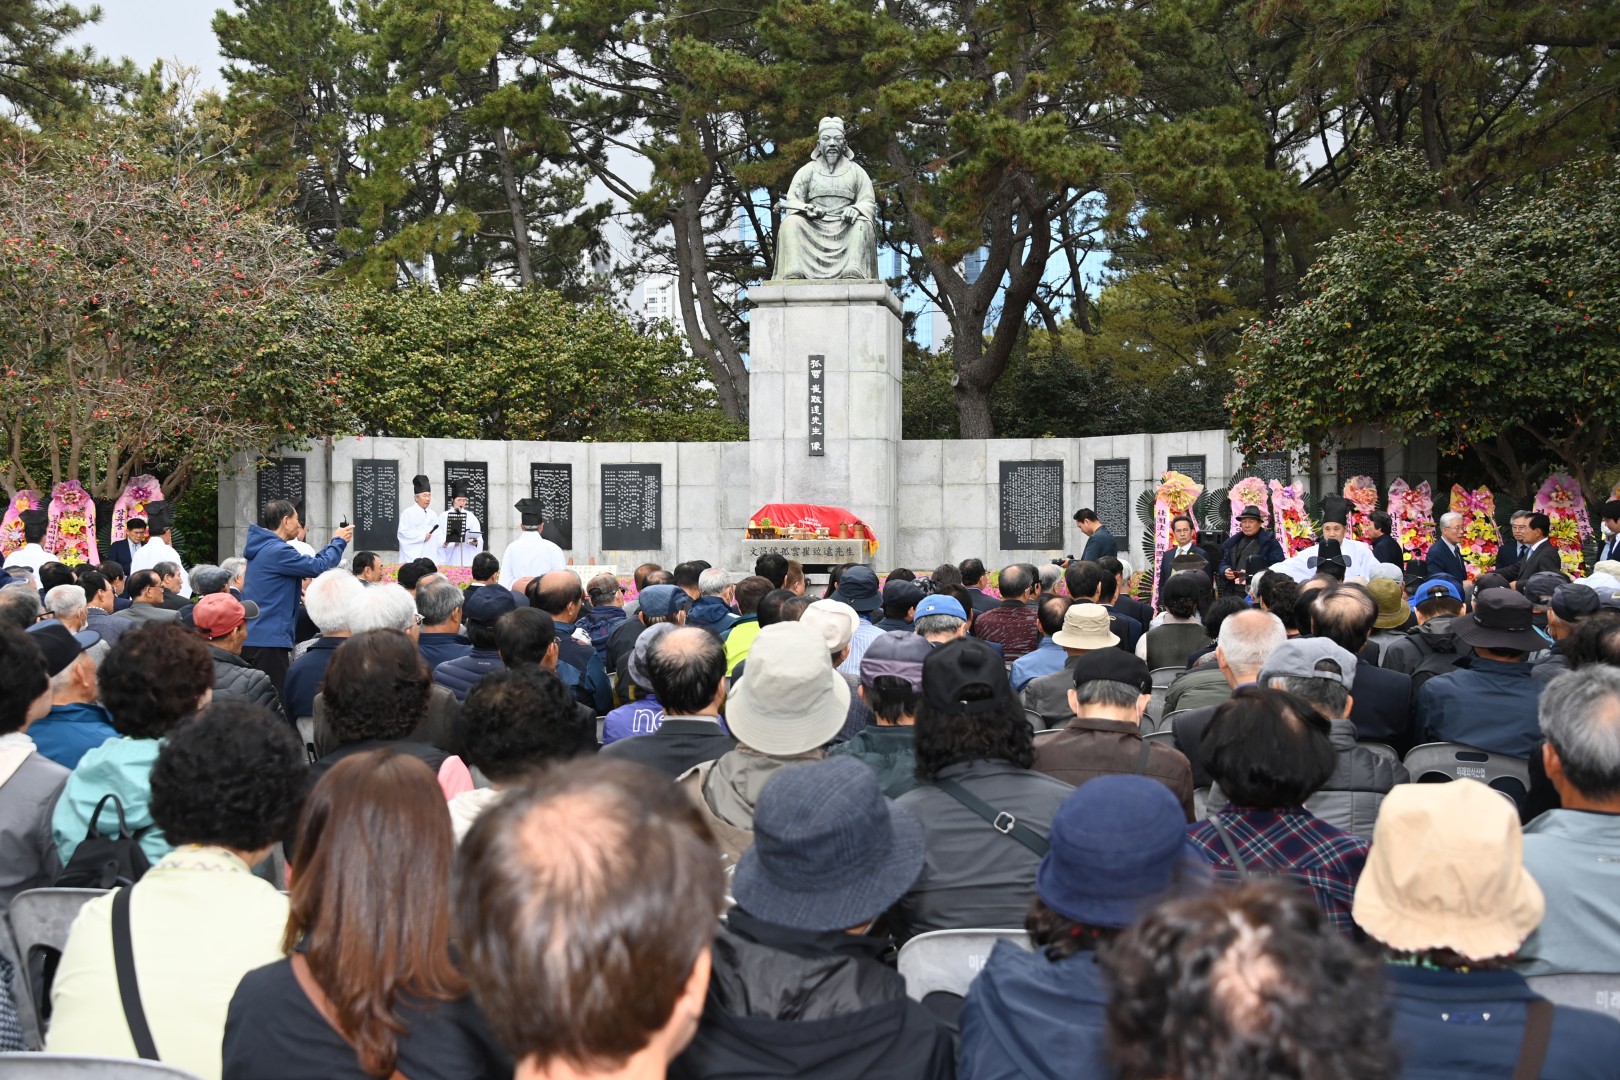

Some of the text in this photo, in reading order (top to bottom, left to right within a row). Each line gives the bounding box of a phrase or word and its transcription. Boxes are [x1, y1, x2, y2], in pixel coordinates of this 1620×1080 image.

[810, 359, 822, 451] 孤雲 崔致遠先生 像
